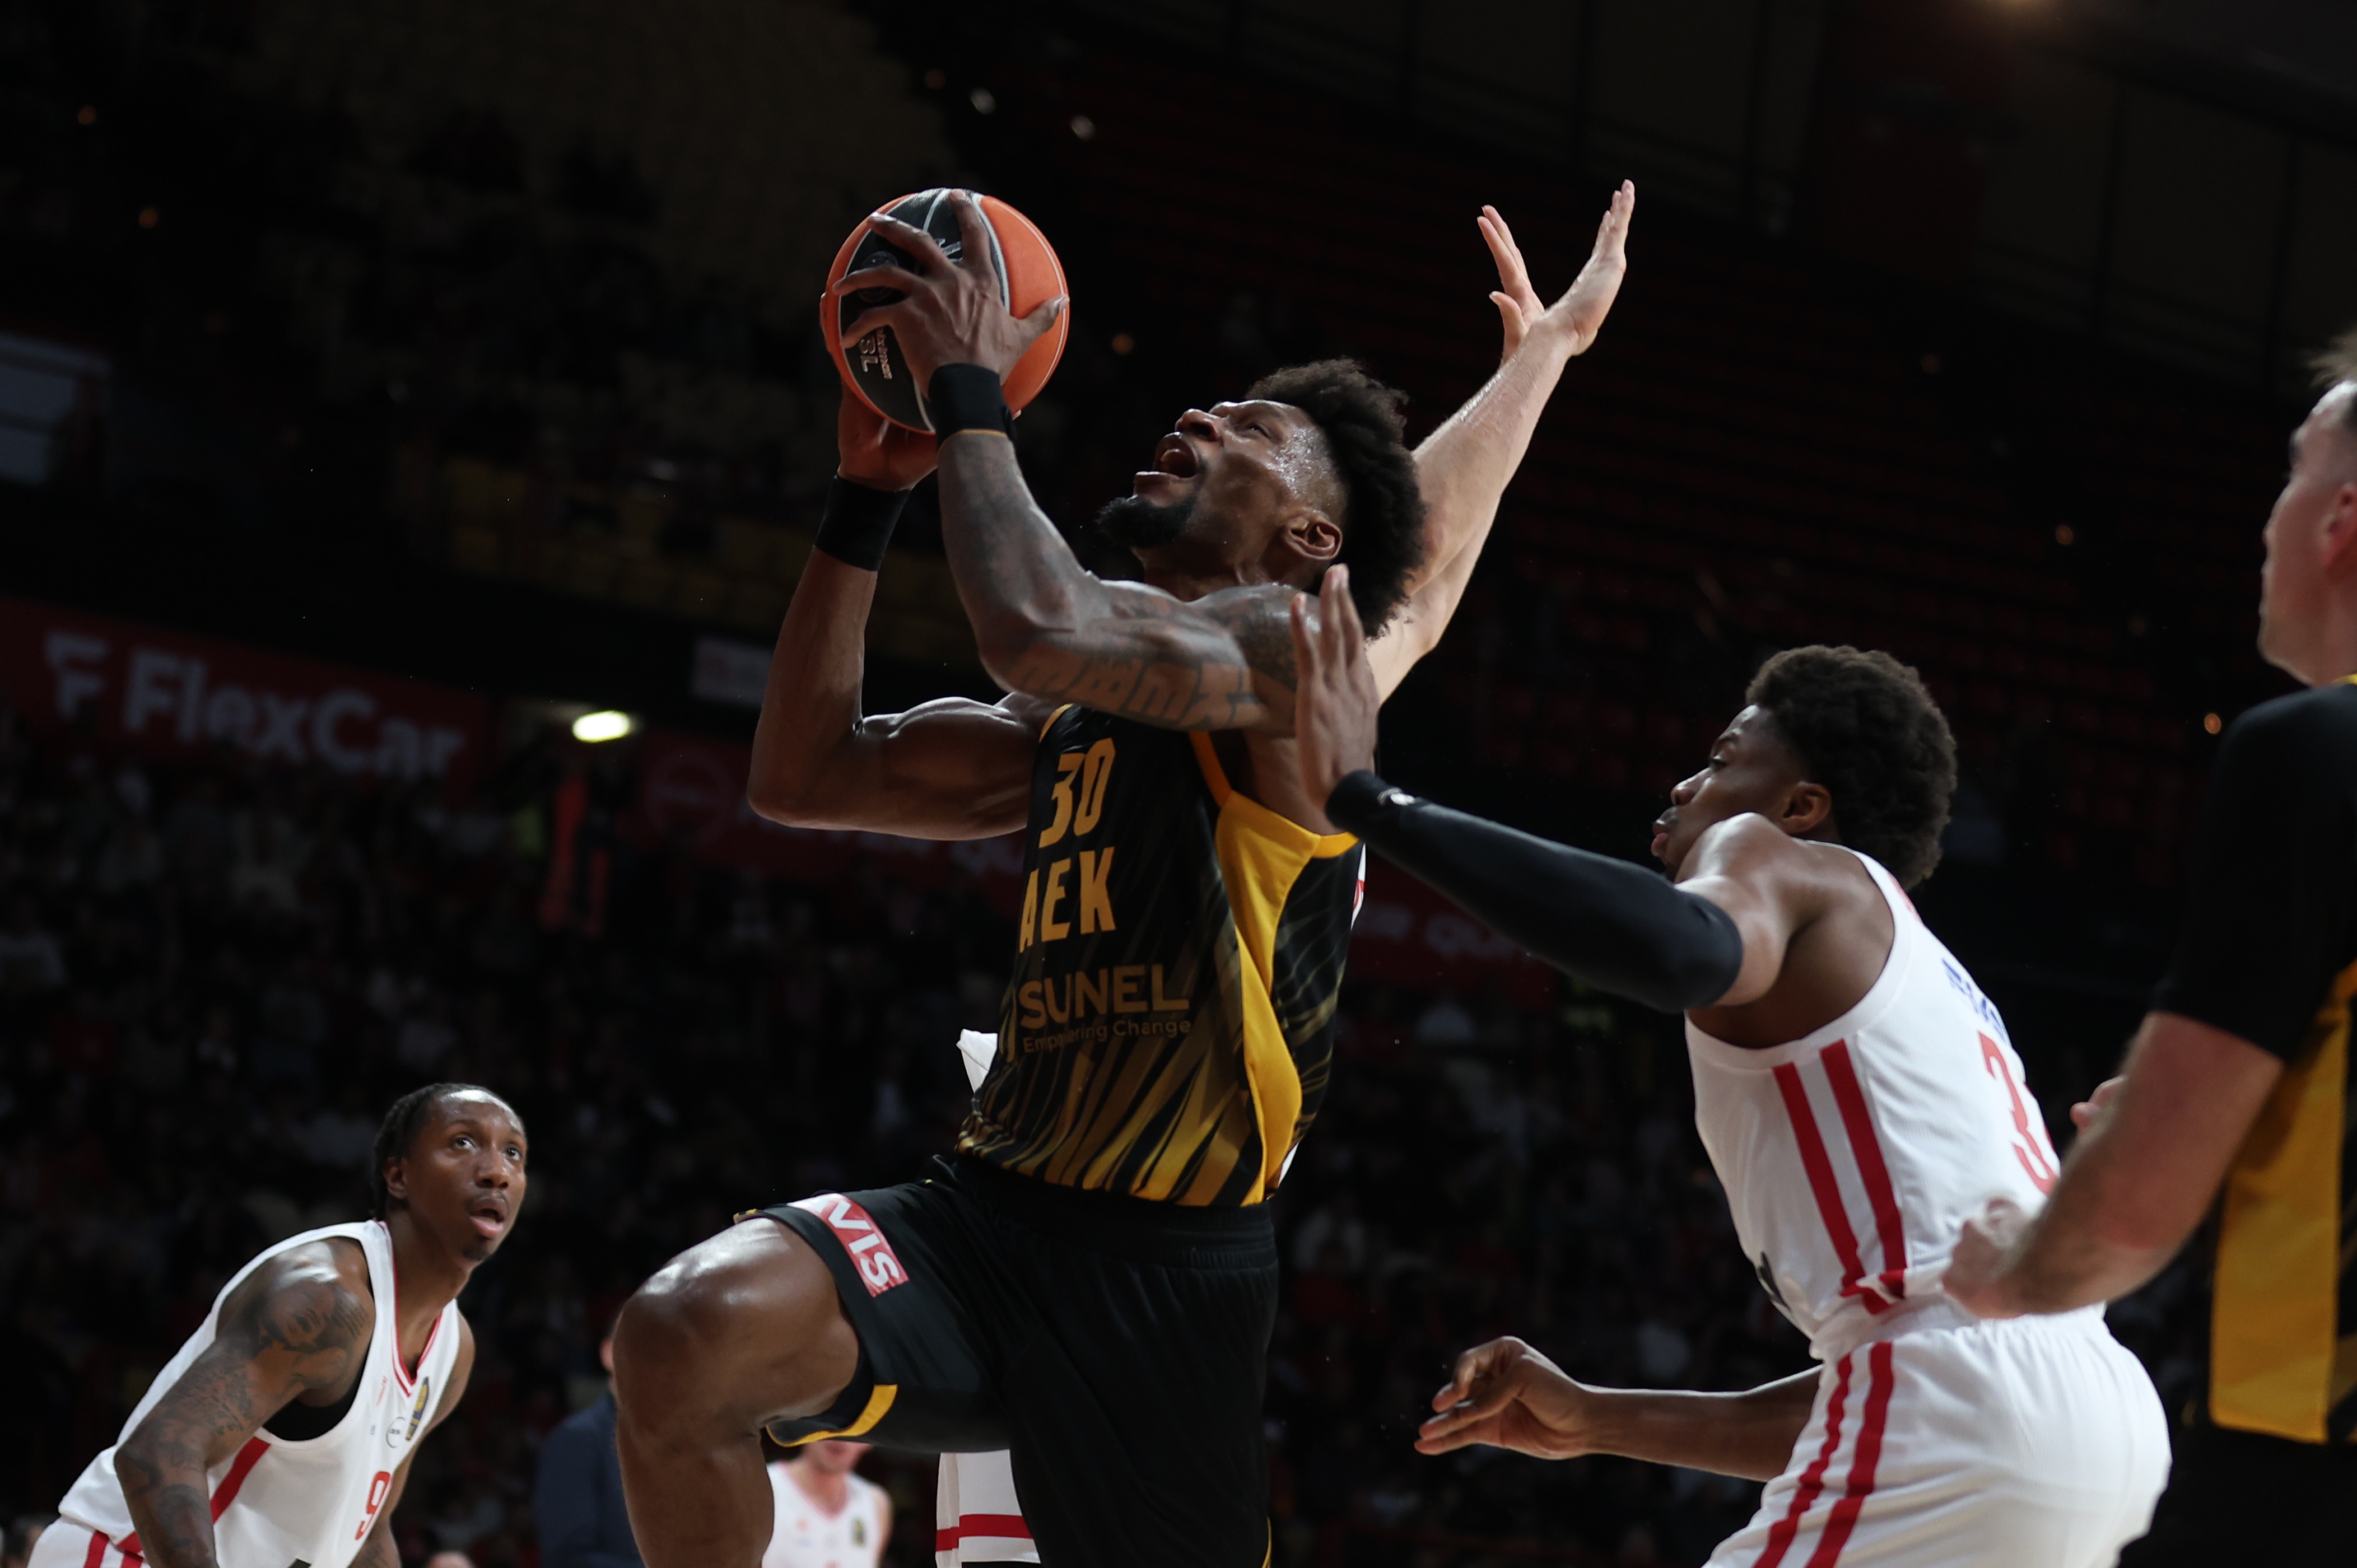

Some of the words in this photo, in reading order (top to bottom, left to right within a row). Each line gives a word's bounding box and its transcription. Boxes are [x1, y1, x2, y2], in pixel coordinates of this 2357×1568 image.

[121, 644, 467, 783] FlexCar
[1038, 737, 1116, 849] 30
[1018, 846, 1117, 954] AEK
[1018, 963, 1190, 1030] SUNEL
[1022, 1024, 1108, 1053] Empering
[1112, 1018, 1192, 1039] Change
[355, 1471, 391, 1541] 9
